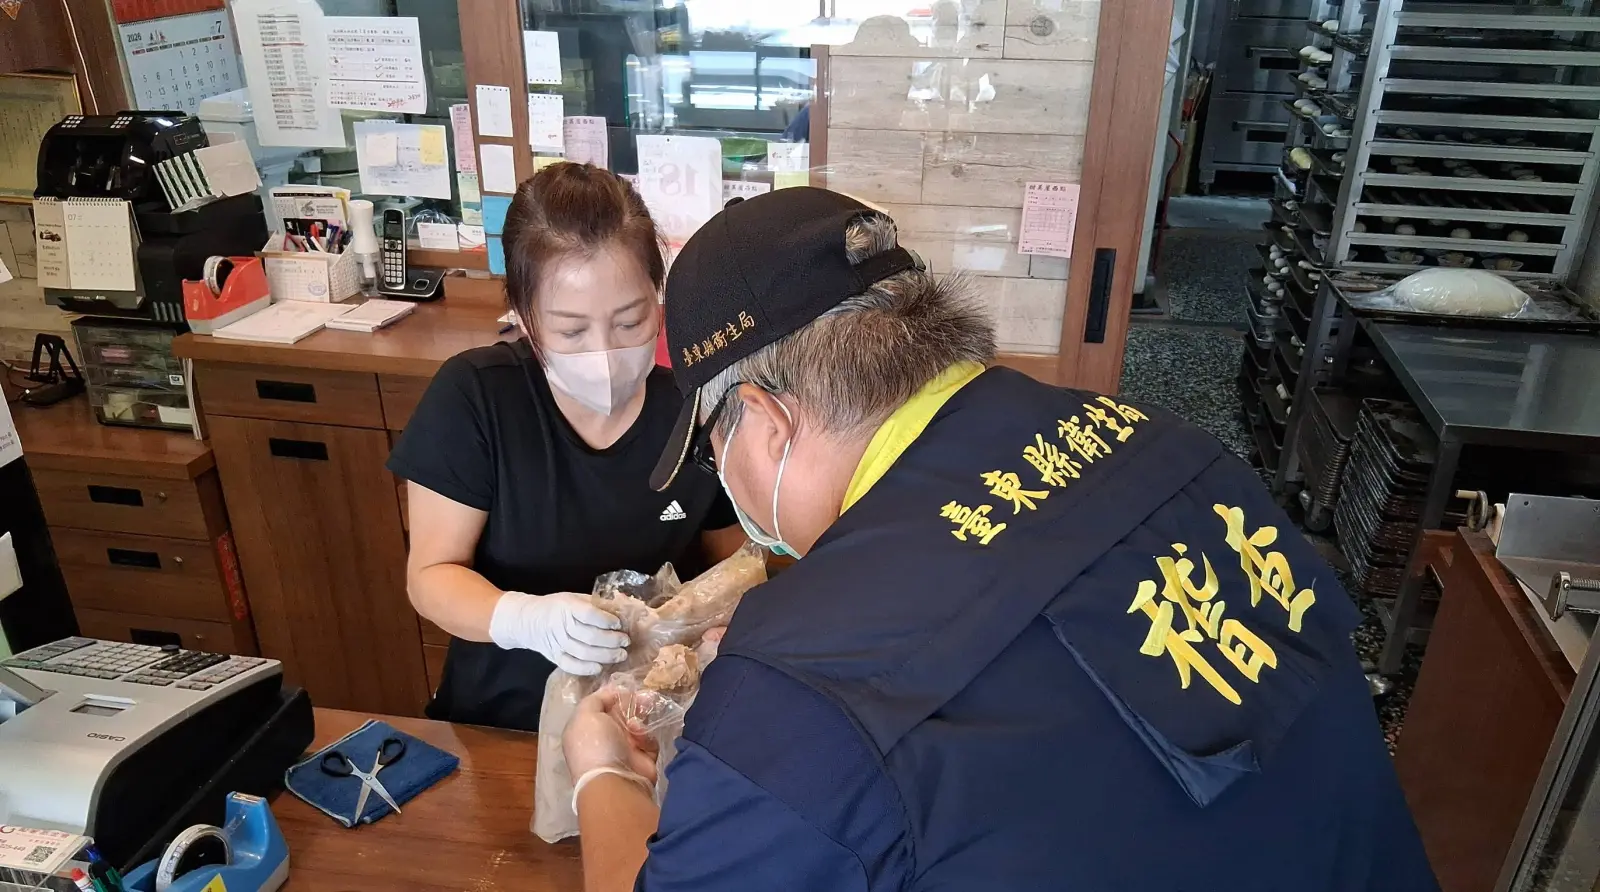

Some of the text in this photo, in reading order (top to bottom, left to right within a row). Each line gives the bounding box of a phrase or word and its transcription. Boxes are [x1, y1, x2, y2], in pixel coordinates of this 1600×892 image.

[216, 20, 222, 33] 7
[127, 32, 142, 42] 2026
[206, 60, 214, 69] 10
[171, 84, 179, 92] 14
[184, 81, 192, 90] 15
[682, 310, 755, 367] 臺東縣衛生局
[940, 396, 1149, 545] 臺東縣衛生局
[660, 512, 687, 521] adidas
[1127, 503, 1315, 706] 稽查
[87, 732, 126, 742] CASIO
